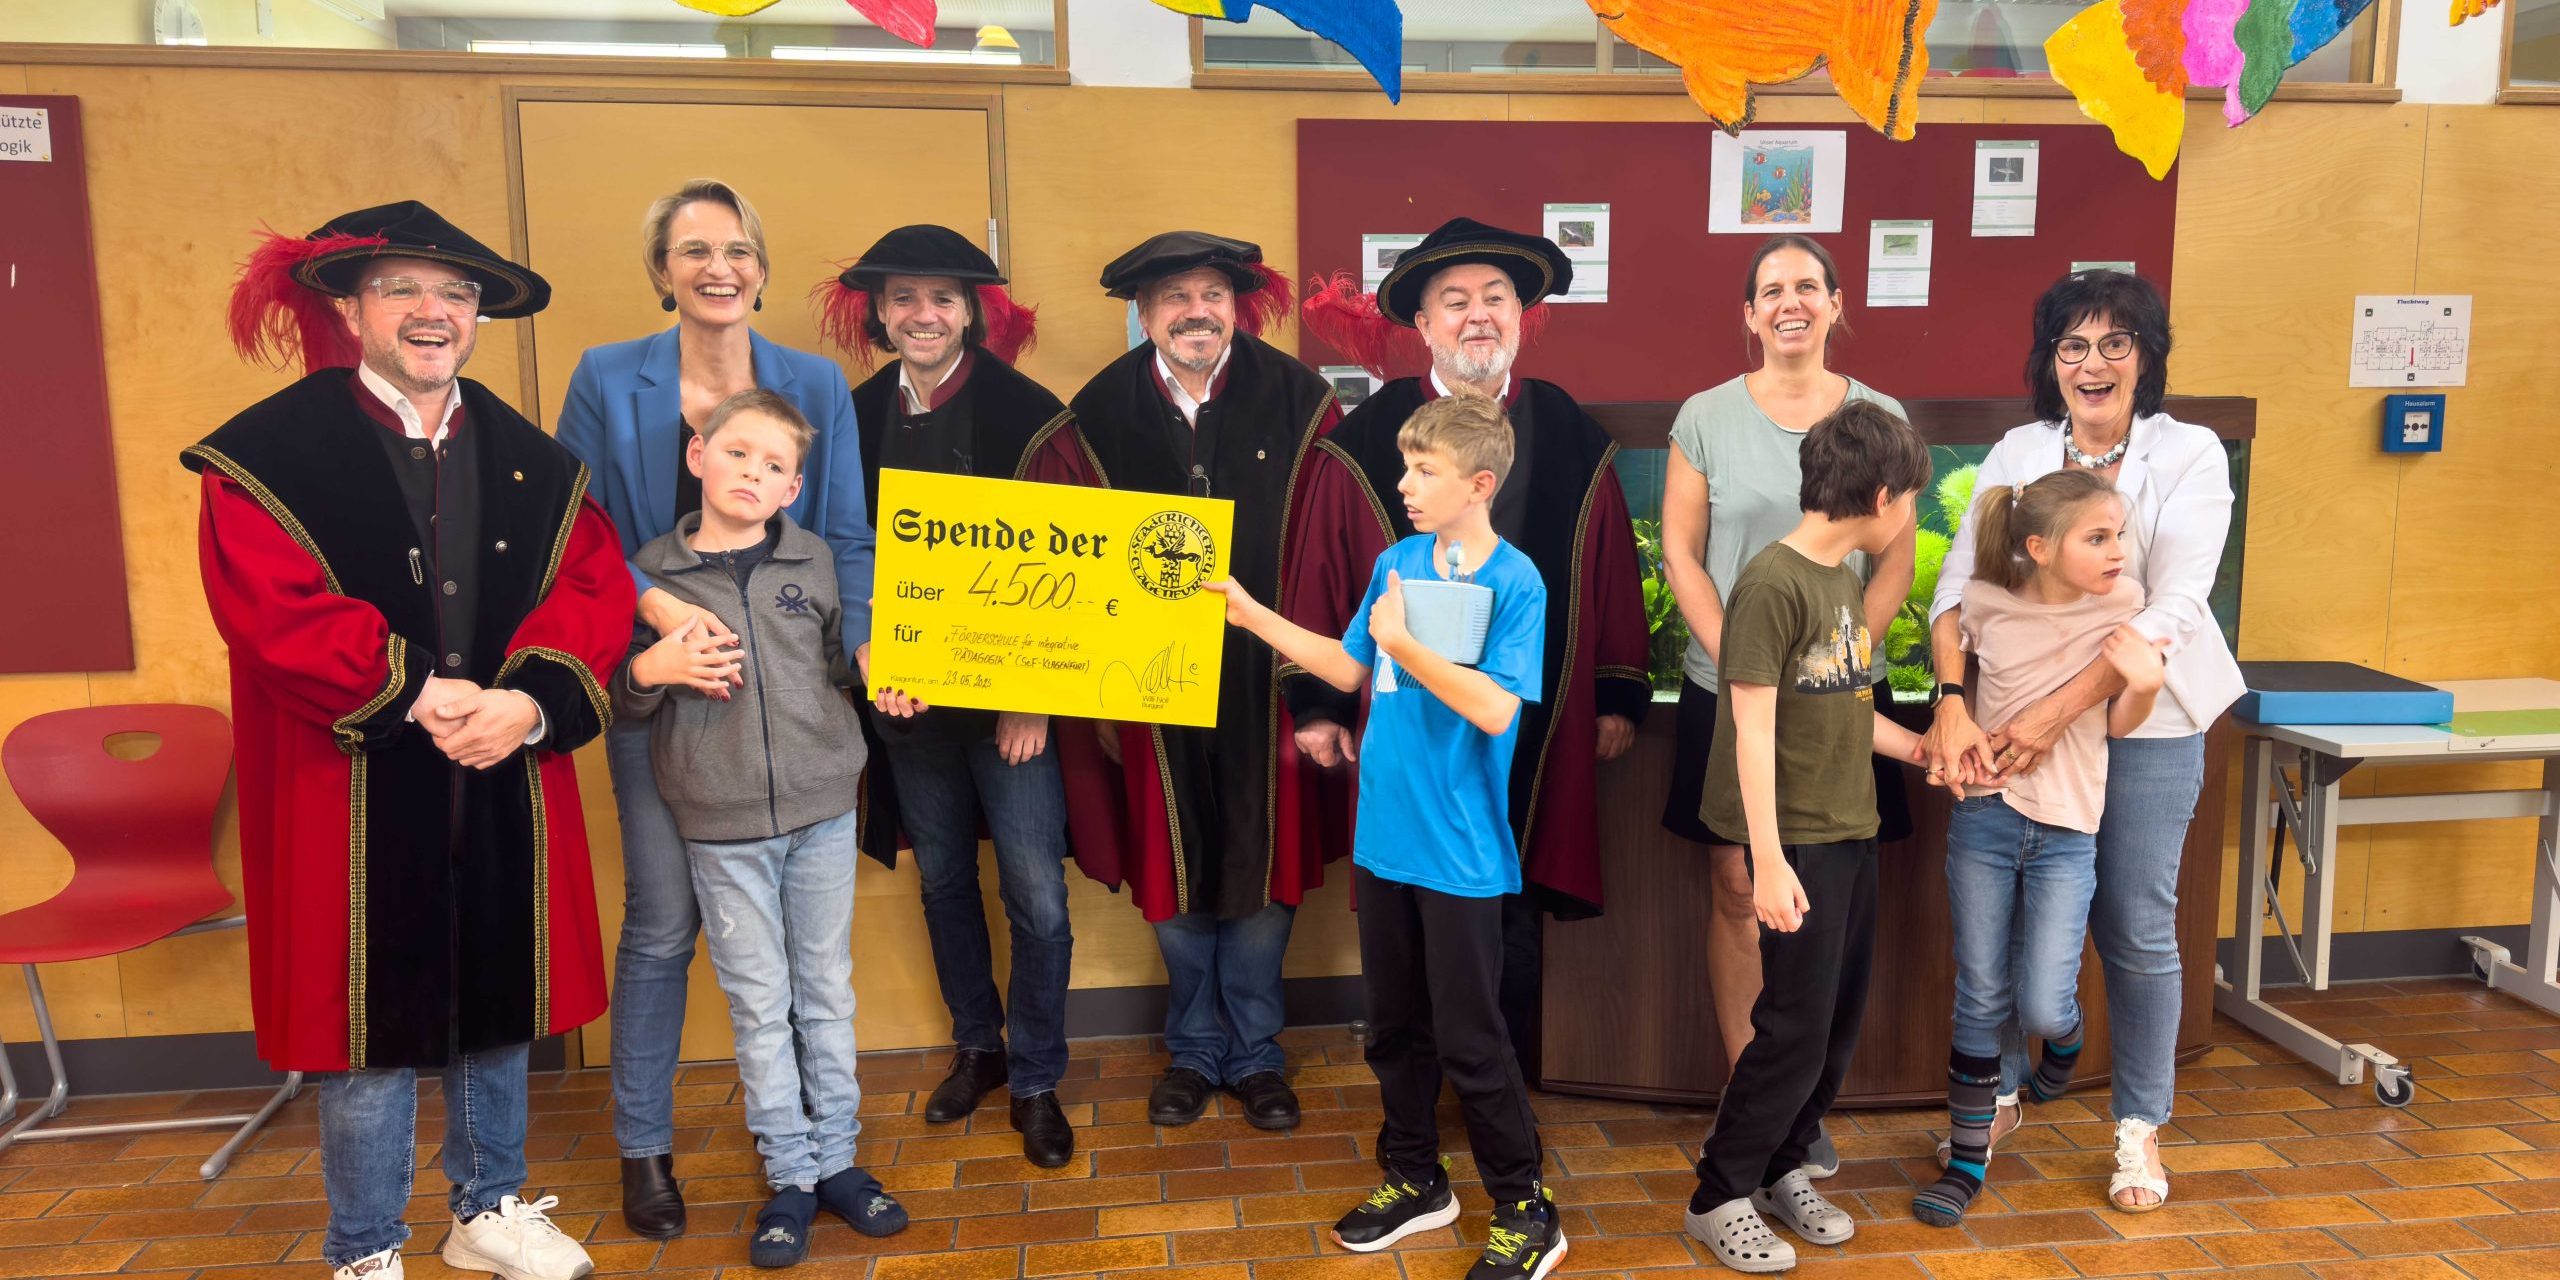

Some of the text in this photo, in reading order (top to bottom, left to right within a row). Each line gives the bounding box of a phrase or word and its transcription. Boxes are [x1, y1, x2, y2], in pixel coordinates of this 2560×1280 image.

[892, 508, 1109, 559] Spende der
[896, 581, 945, 601] über
[1105, 599, 1119, 617] €
[893, 623, 923, 643] für
[1038, 636, 1080, 653] integrative
